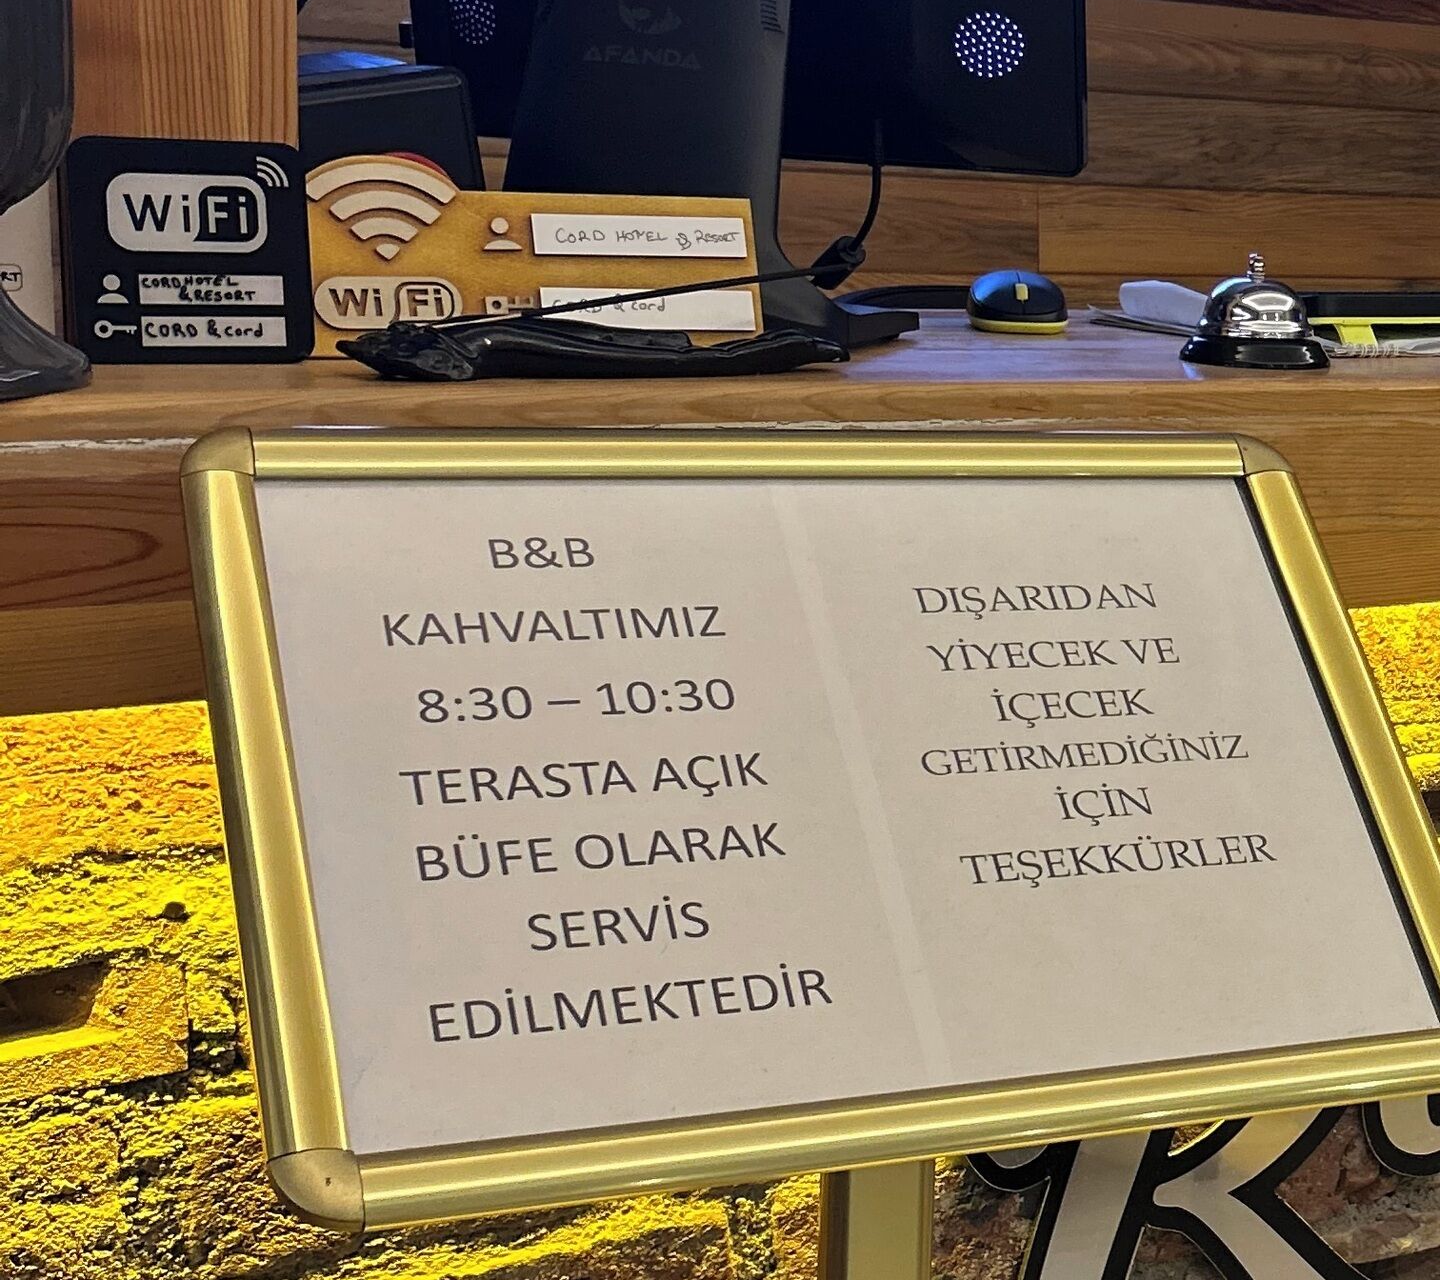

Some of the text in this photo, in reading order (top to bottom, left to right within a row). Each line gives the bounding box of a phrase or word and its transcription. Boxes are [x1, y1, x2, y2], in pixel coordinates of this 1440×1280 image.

[122, 193, 249, 234] WiFi
[328, 287, 445, 317] WiFi
[144, 322, 199, 338] CORD
[487, 536, 596, 570] B&B
[912, 582, 1159, 620] DIŞARIDAN
[381, 605, 727, 648] KAHVALTIMIZ
[926, 637, 1181, 672] YİYECEK VE
[417, 685, 533, 724] 8:30
[597, 678, 736, 717] 10:30
[991, 687, 1155, 729] İÇECEK
[920, 729, 1250, 777] GETİRMEDİĞİNİZ
[399, 752, 768, 806] TERASTA AÇIK
[1054, 782, 1154, 827] İÇİN
[416, 821, 787, 882] BÜFE OLARAK
[958, 832, 1278, 889] TEŞEKKÜRLER
[526, 894, 711, 952] SERVİS
[428, 962, 834, 1043] EDİLMEKTEDİR
